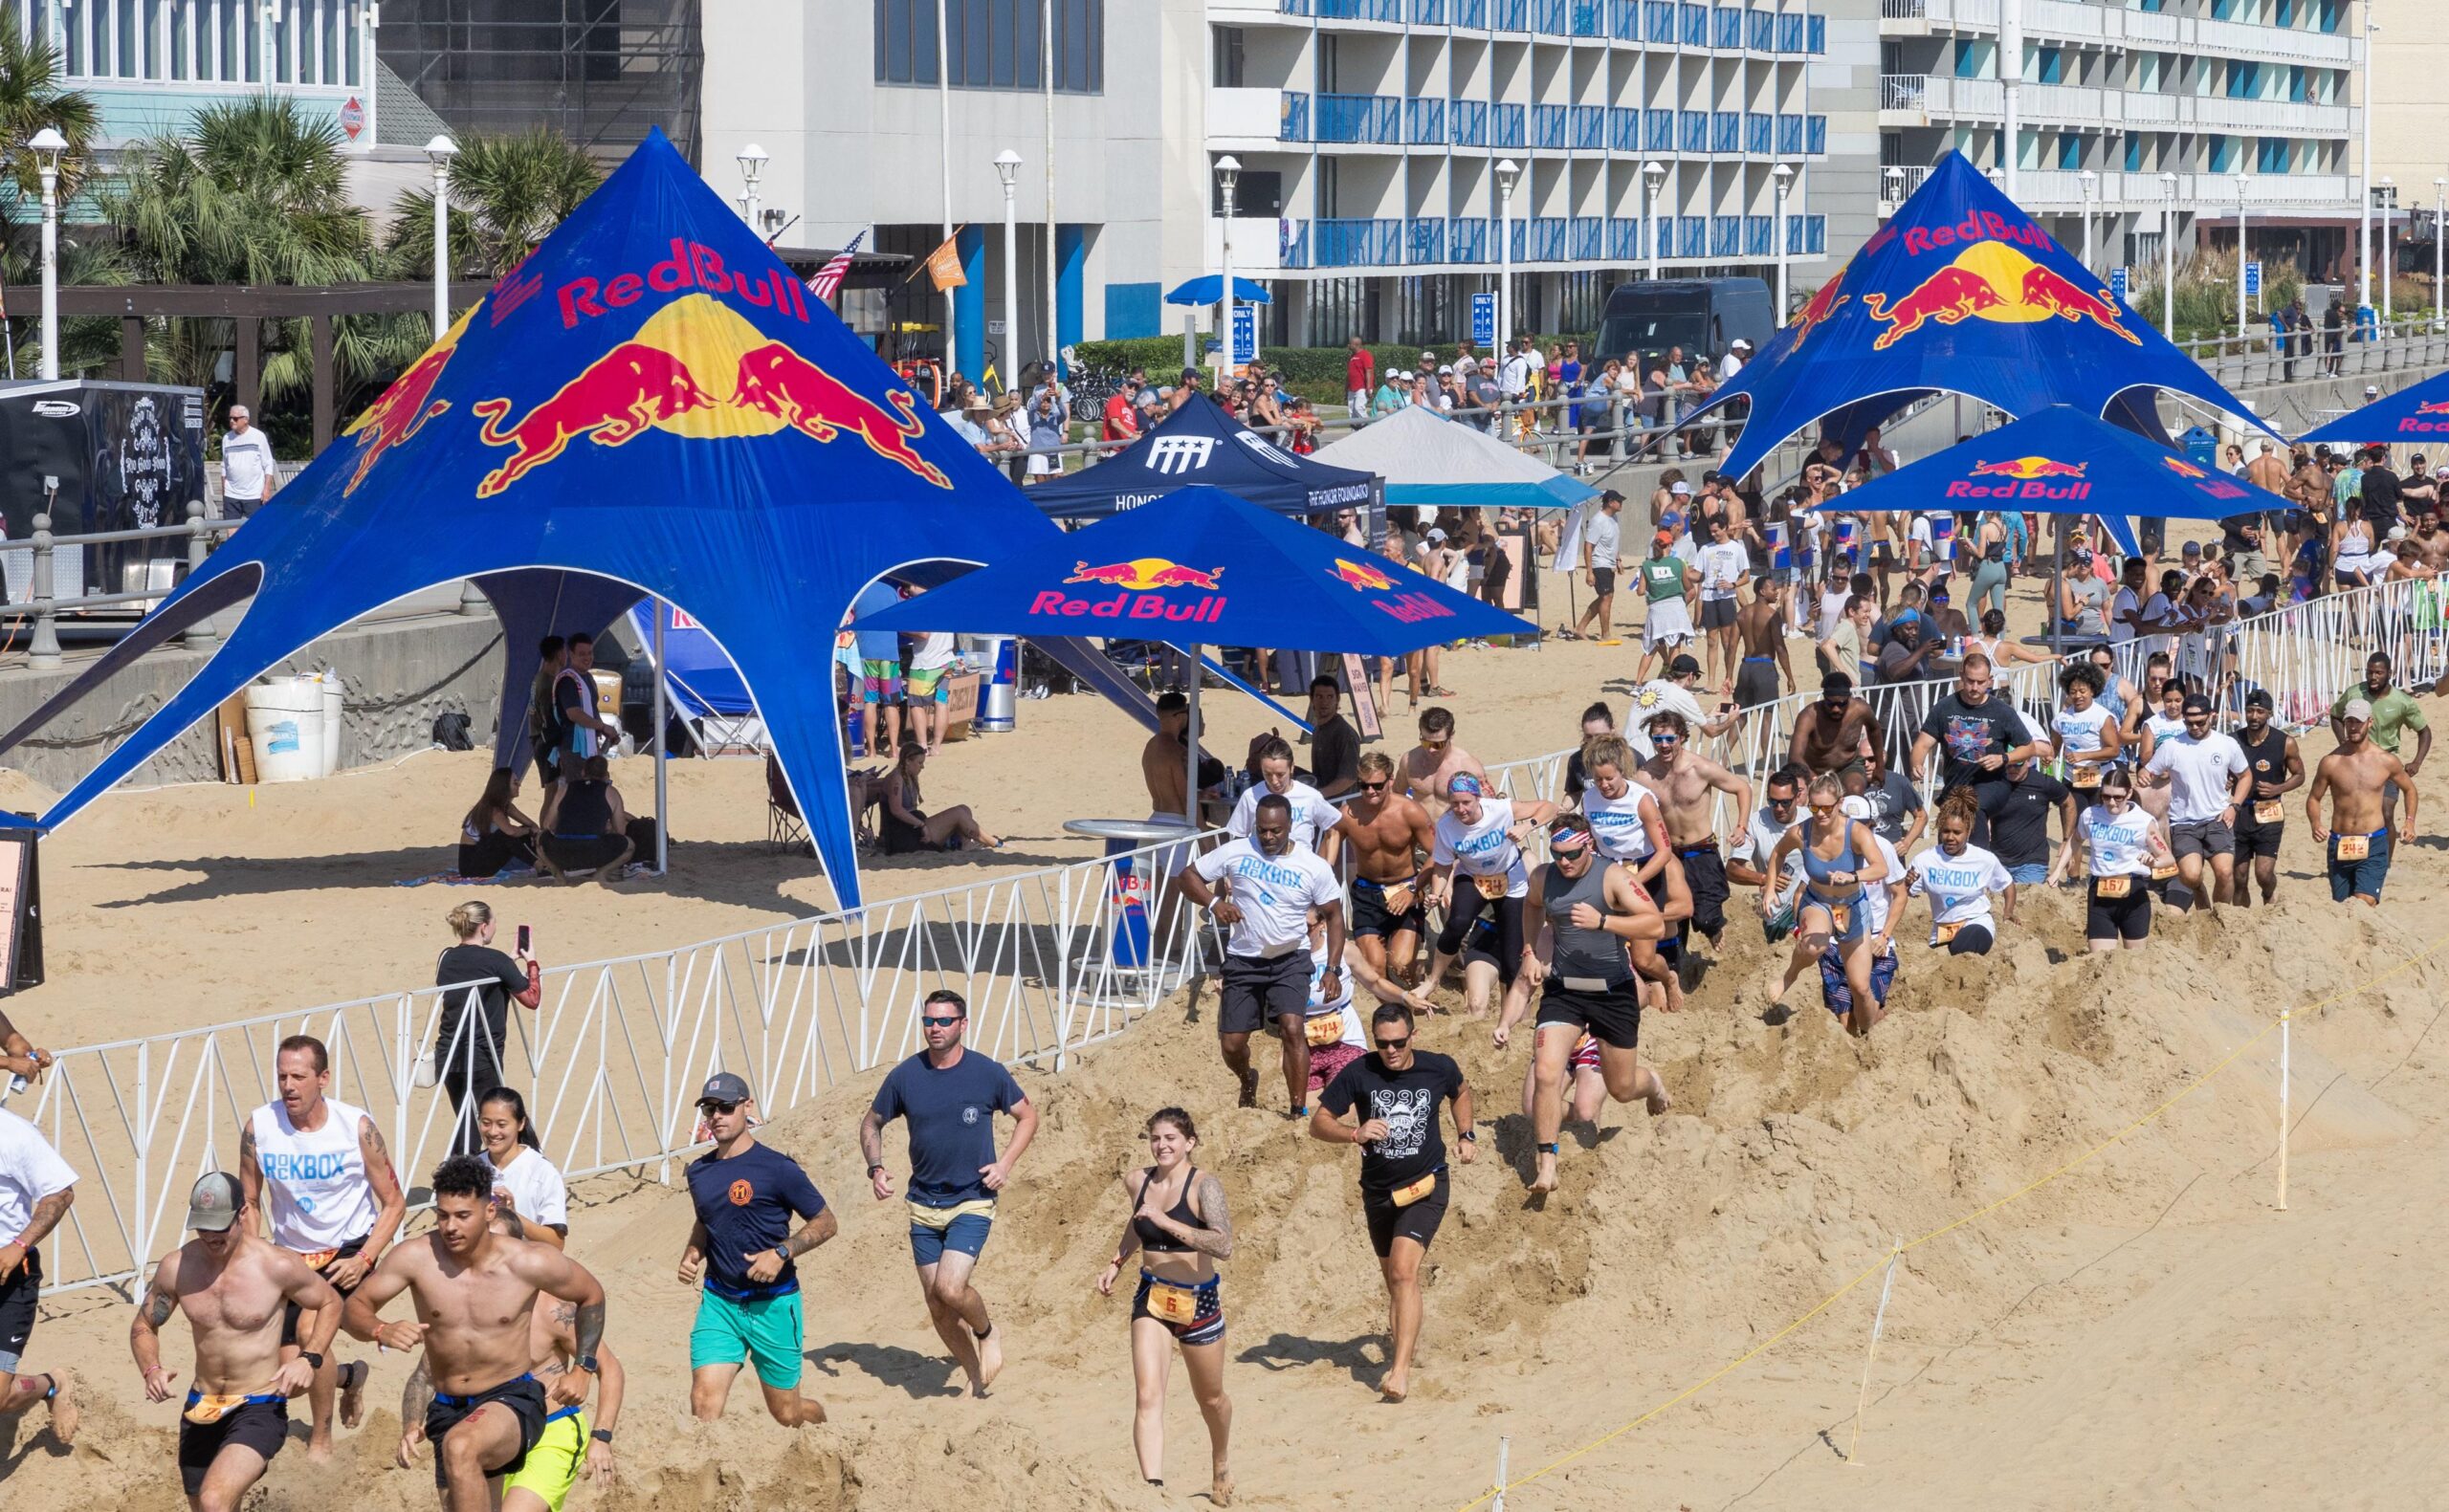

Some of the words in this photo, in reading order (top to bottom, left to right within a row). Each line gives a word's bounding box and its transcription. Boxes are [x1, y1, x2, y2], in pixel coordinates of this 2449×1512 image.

[1904, 208, 1984, 256] Red
[1979, 210, 2054, 253] Bull
[557, 237, 694, 329] Red
[688, 240, 809, 323] Bull
[1233, 310, 1250, 318] ONLY
[1318, 488, 1338, 506] HONOR
[1945, 481, 2019, 497] Red
[2019, 482, 2092, 500] Bull
[1028, 590, 1130, 618] Red
[1129, 595, 1228, 623] Bull
[2342, 844, 2364, 854] 242
[2102, 879, 2125, 891] 167
[1313, 1020, 1338, 1040] 174
[1371, 1088, 1431, 1107] 1999
[735, 1186, 745, 1198] 11
[1166, 1297, 1177, 1313] 6
